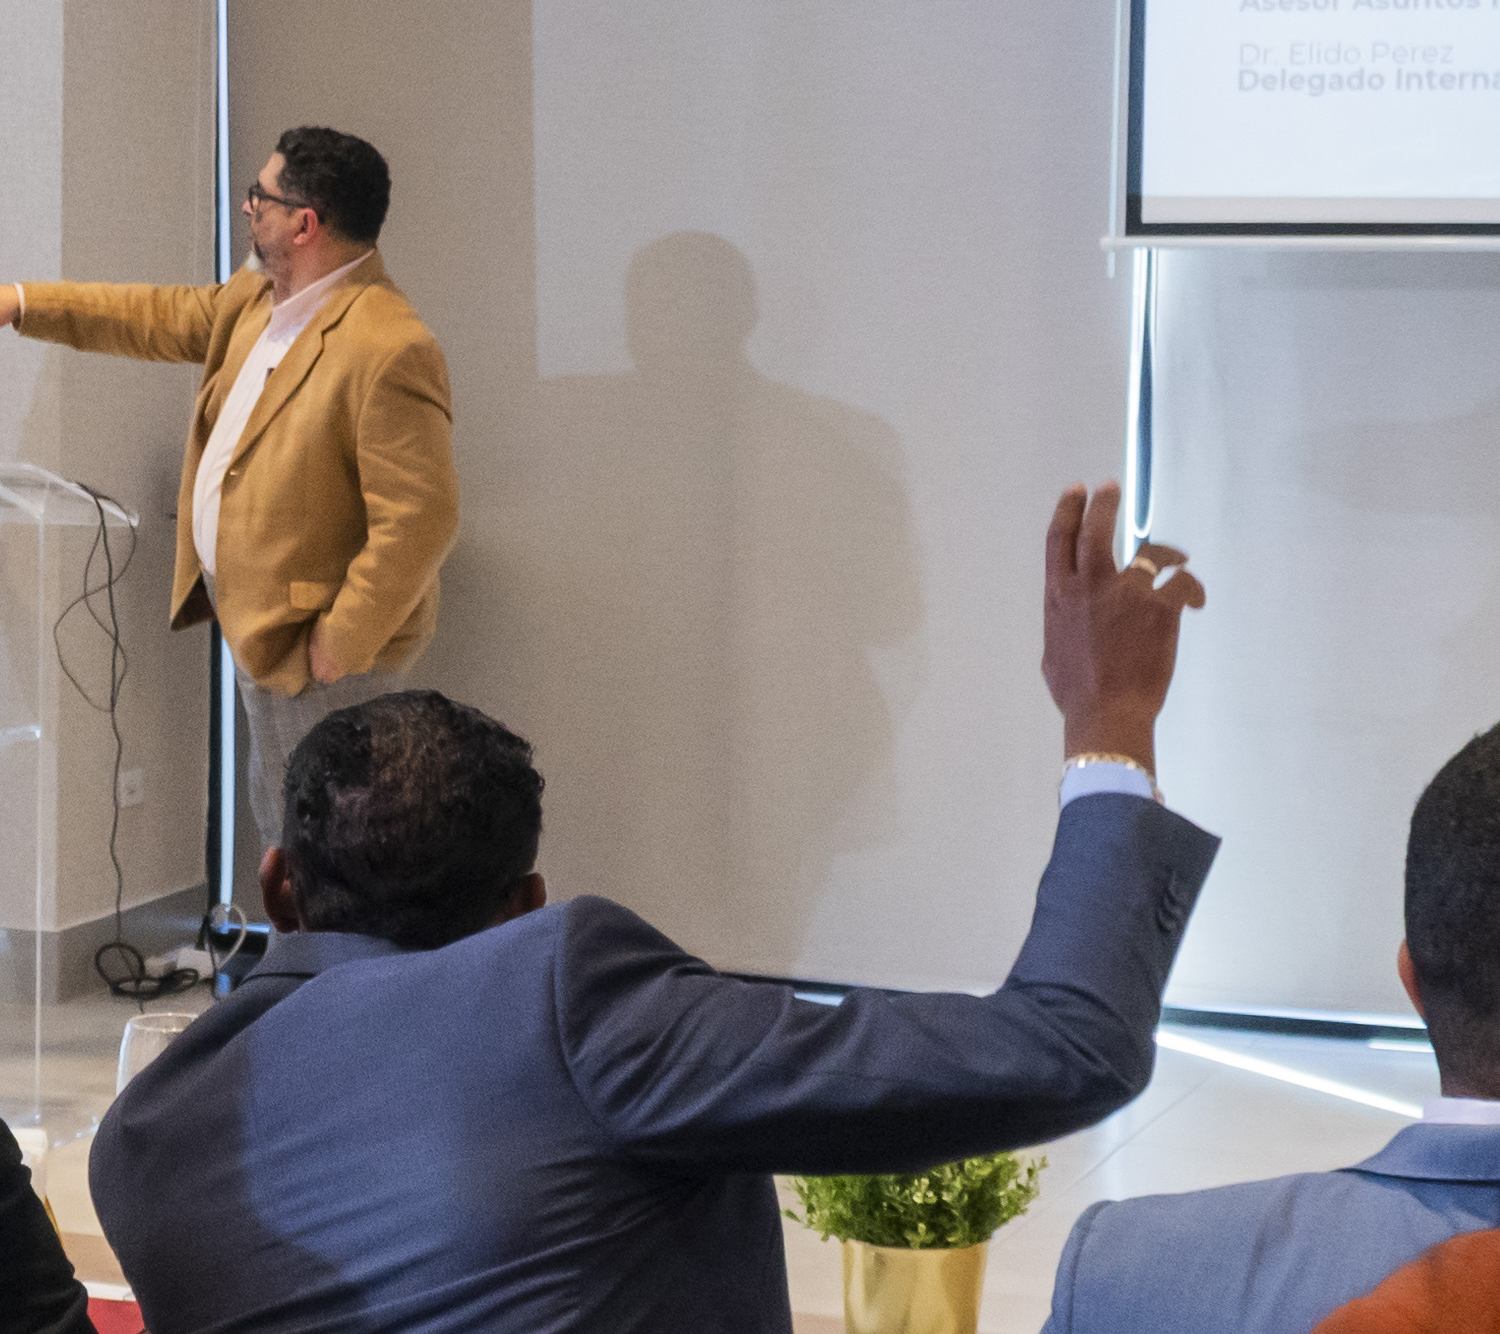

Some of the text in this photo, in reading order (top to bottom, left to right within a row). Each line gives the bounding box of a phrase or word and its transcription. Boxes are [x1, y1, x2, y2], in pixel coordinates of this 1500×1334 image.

[1239, 42, 1278, 66] Dr.
[1289, 41, 1361, 65] Elido
[1238, 66, 1385, 97] Delegado
